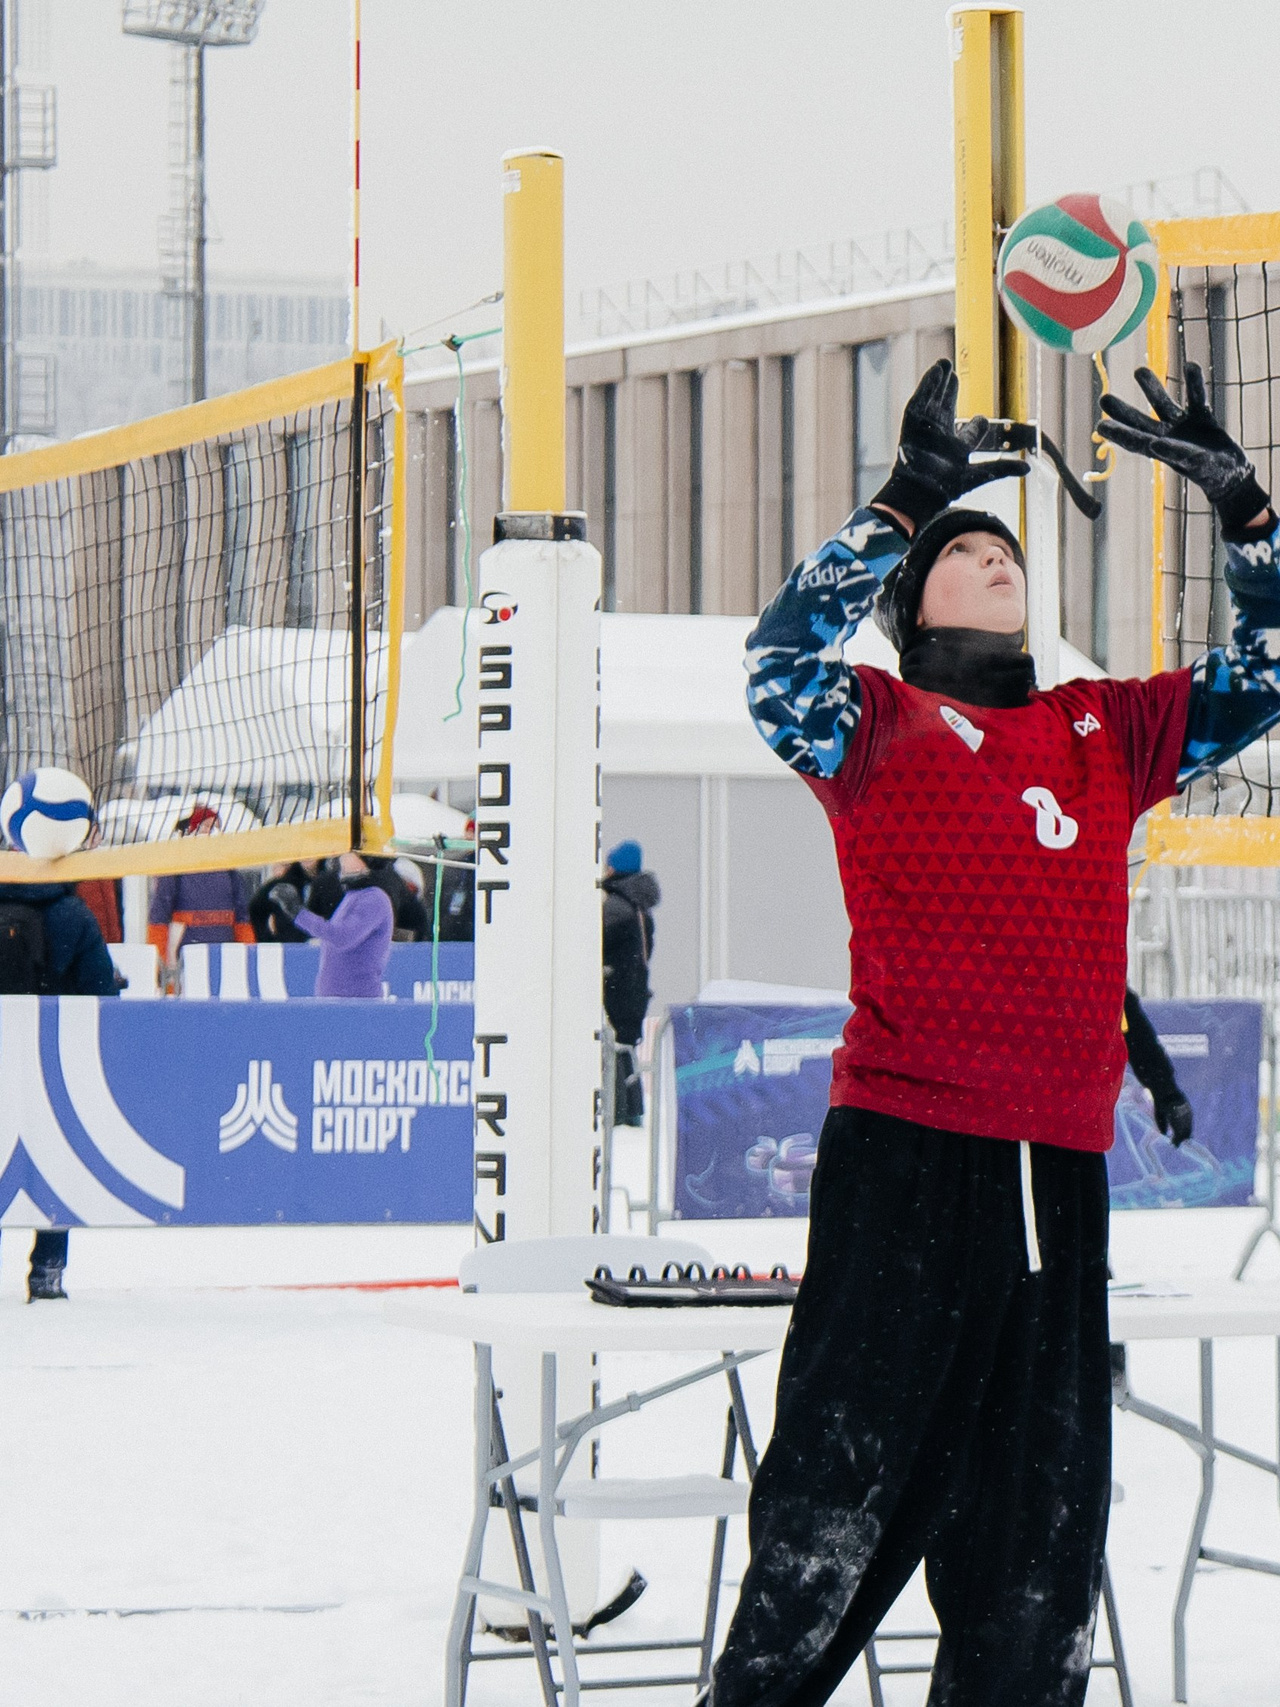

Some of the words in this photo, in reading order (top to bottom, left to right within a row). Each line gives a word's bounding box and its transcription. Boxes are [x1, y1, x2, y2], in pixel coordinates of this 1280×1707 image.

[1026, 239, 1084, 286] molten
[313, 1059, 474, 1107] МОСКОВС
[312, 1106, 417, 1154] СПОРТ
